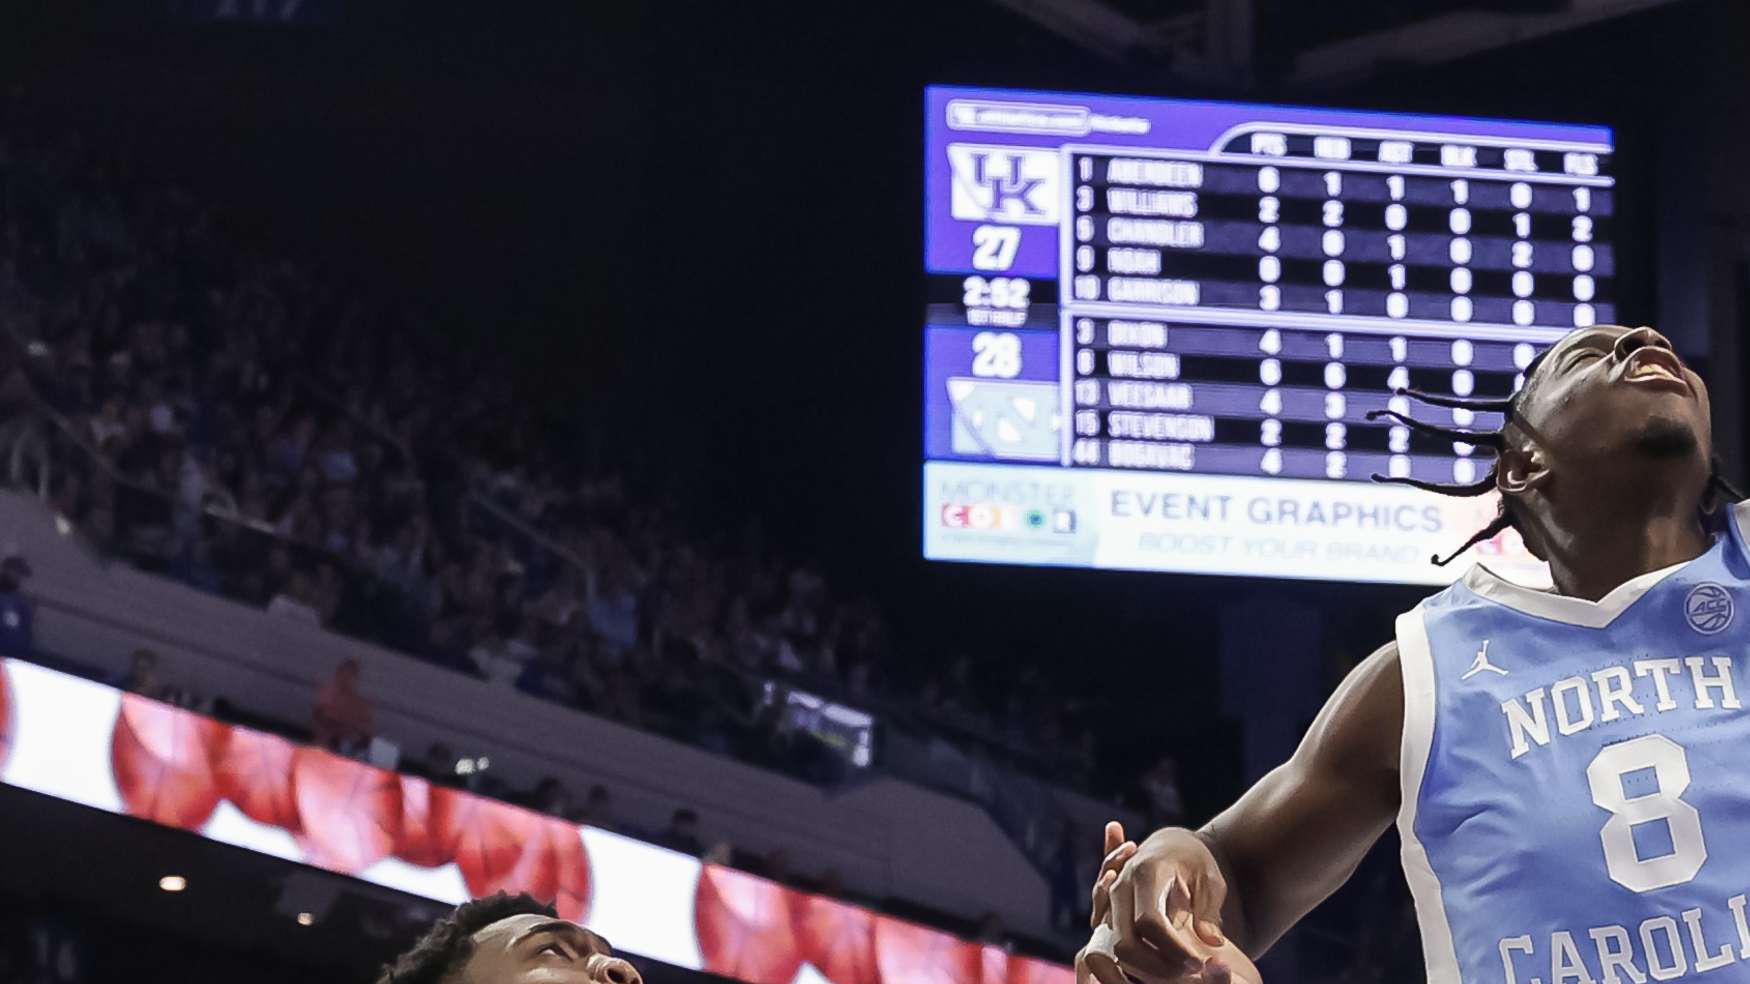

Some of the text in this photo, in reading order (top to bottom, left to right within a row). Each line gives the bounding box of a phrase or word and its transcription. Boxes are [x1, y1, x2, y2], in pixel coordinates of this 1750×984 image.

[972, 153, 1046, 216] UK
[1325, 173, 1340, 195] 1
[1388, 176, 1403, 199] 1
[1452, 180, 1467, 203] 1
[1574, 188, 1589, 211] 1
[1516, 214, 1529, 236] 1
[973, 226, 1020, 270] 27
[1388, 235, 1404, 259] 1
[964, 277, 1029, 308] 2:52
[1391, 265, 1404, 288] 1
[1327, 291, 1342, 313] 1
[973, 333, 1021, 378] 28
[1327, 334, 1343, 357] 1
[1390, 338, 1406, 361] 1
[1110, 489, 1444, 534] EVENT GRAPHICS
[1138, 531, 1233, 553] BOOST
[1244, 537, 1317, 560] YOUR
[1502, 656, 1741, 759] NORTH
[1586, 733, 1708, 892] 8
